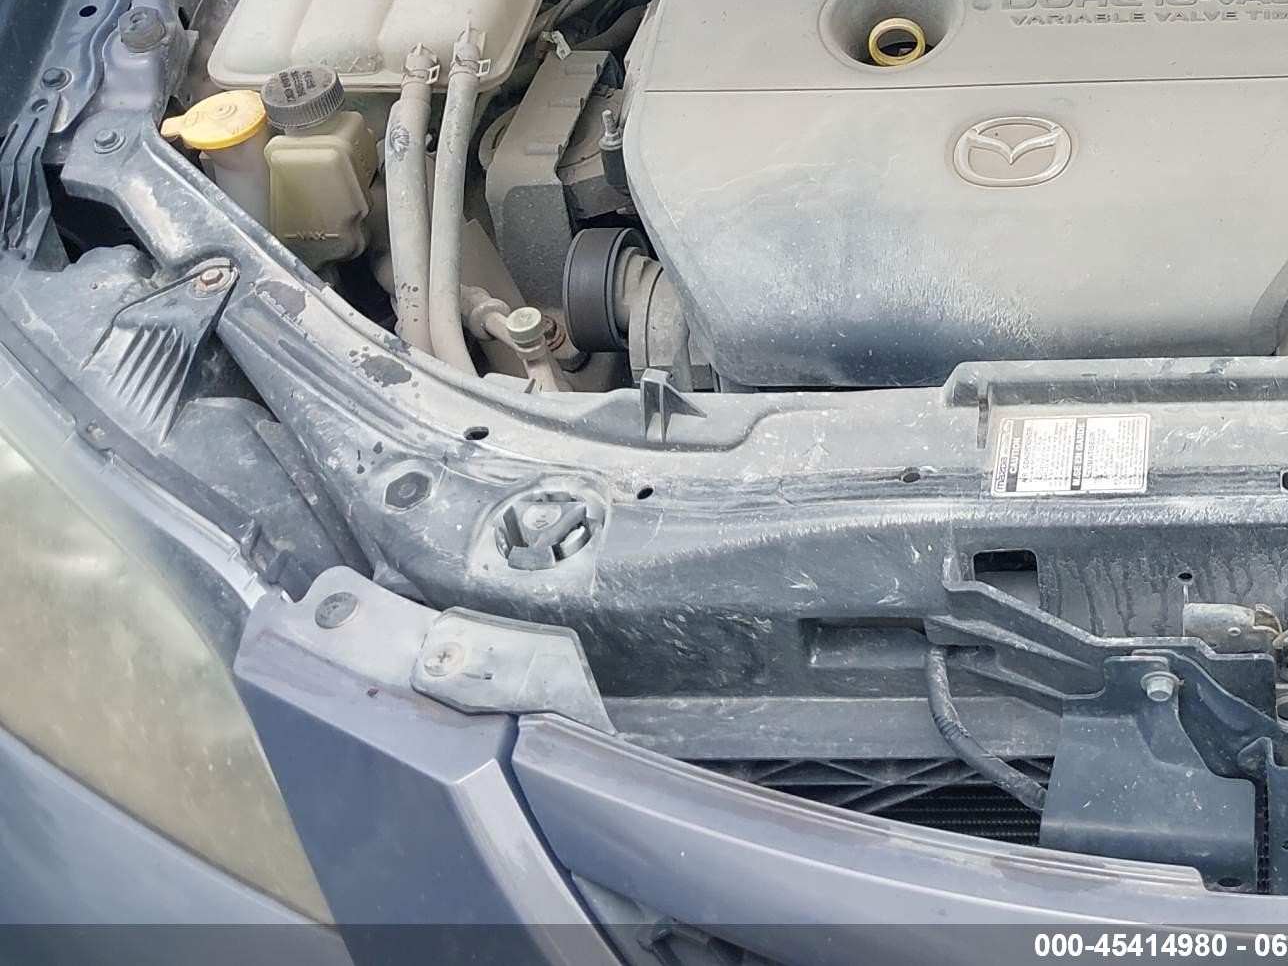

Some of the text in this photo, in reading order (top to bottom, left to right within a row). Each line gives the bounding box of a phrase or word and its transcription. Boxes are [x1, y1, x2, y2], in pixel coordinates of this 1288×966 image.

[1010, 13, 1146, 26] VARIABLE
[1154, 11, 1240, 22] VALVE
[1009, 436, 1021, 474] CAUTION
